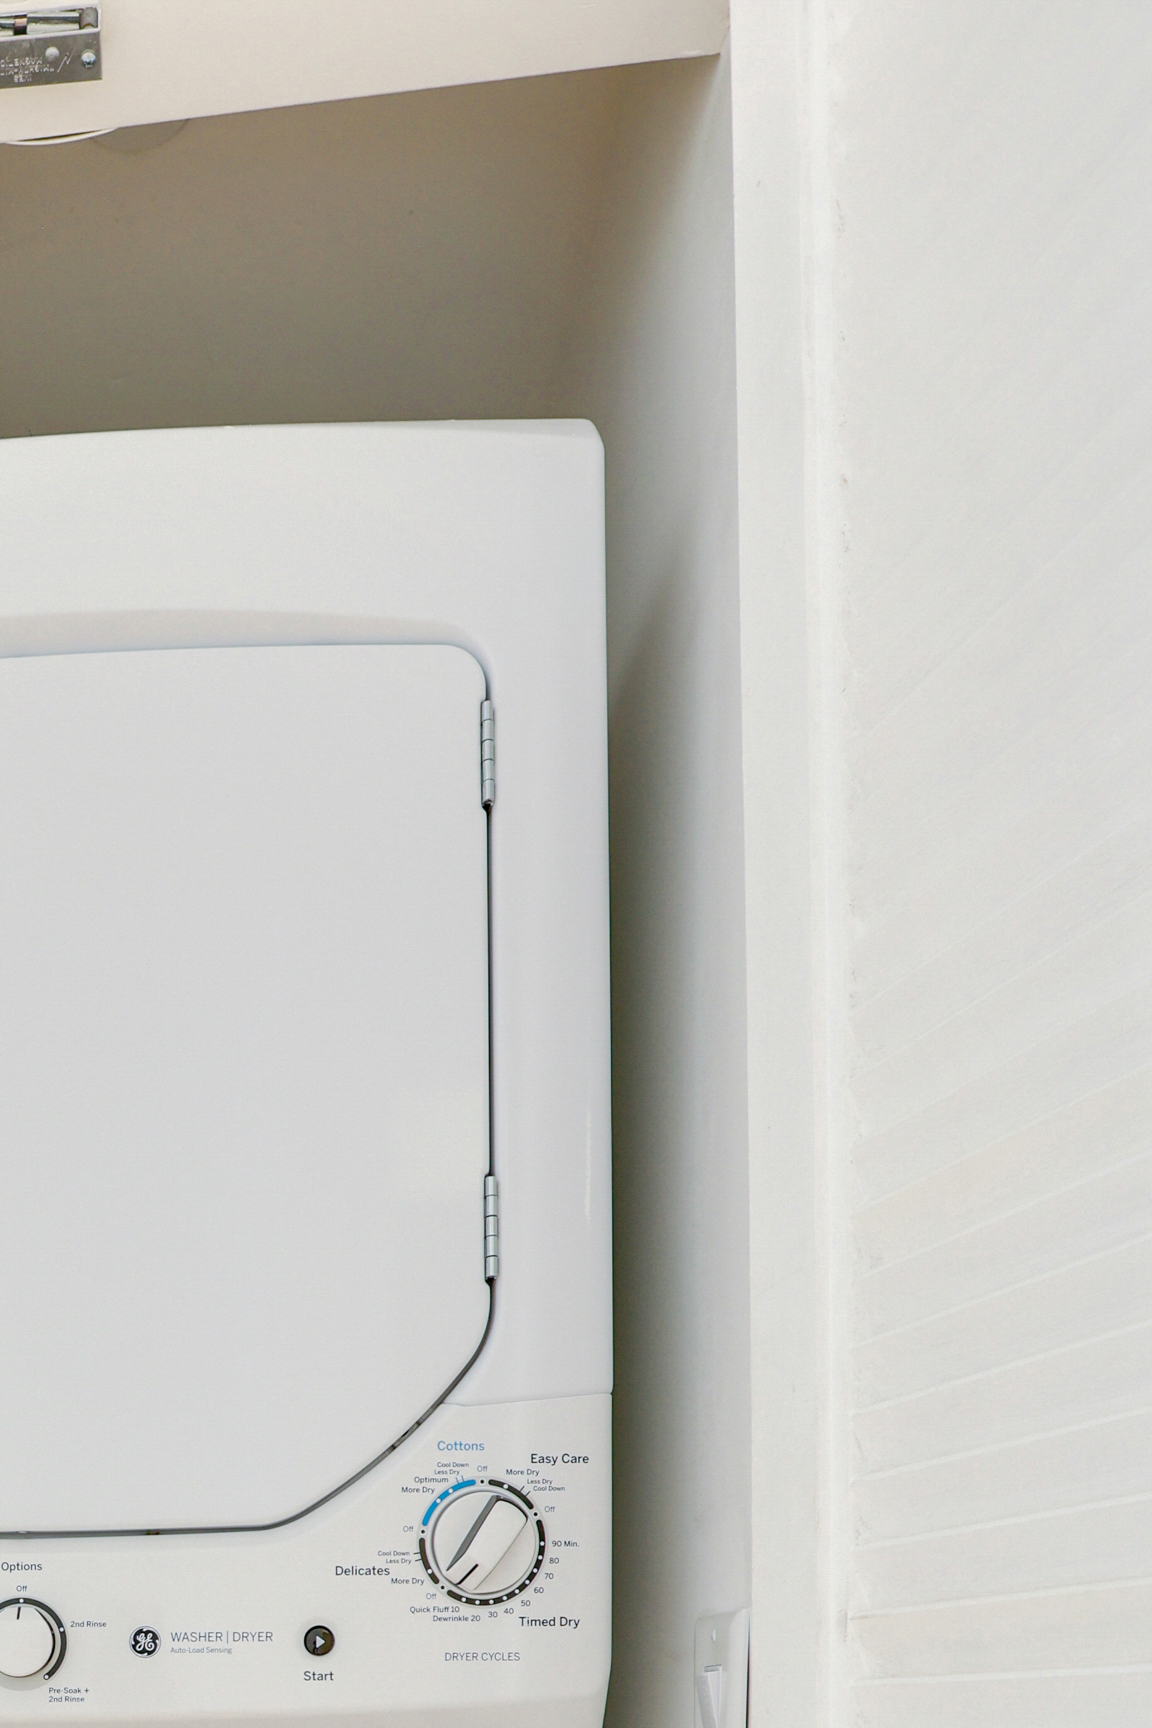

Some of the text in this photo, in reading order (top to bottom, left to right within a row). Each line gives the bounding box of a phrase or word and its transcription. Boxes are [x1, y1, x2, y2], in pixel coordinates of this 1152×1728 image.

[437, 1440, 485, 1451] Cottons
[531, 1453, 589, 1466] Easy Care
[414, 1476, 448, 1484] Optimum
[422, 1486, 435, 1494] Dry
[1, 1561, 42, 1573] Options
[335, 1565, 390, 1576] Delicates
[412, 1578, 424, 1586] Dry
[410, 1606, 430, 1614] Quick
[71, 1620, 107, 1628] 2nd Rinse
[519, 1616, 580, 1629] Timed Dry
[131, 1628, 159, 1655] GE
[171, 1631, 273, 1643] WASHER DRYER
[206, 1647, 232, 1655] Sensing
[445, 1652, 520, 1661] DRYER CYCLES
[304, 1670, 334, 1681] Start
